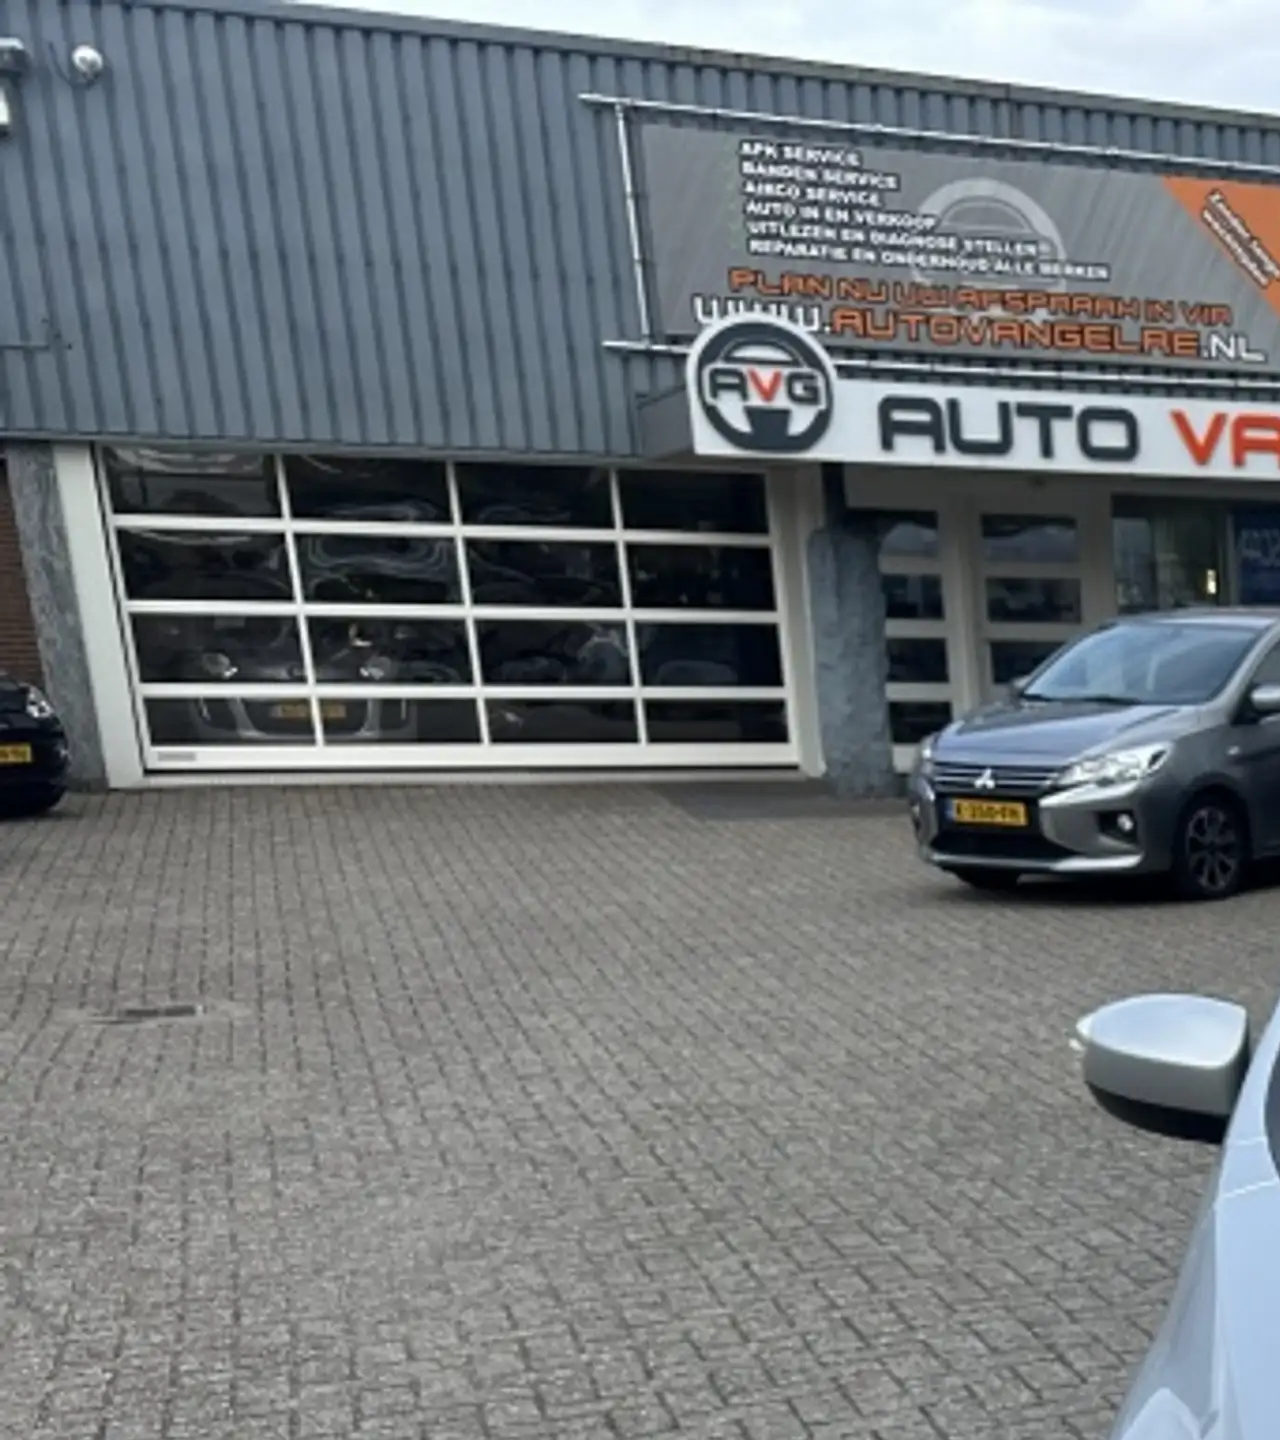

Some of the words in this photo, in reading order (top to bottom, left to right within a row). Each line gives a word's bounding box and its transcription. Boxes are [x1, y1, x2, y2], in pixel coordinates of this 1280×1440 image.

[741, 142, 777, 159] APK
[783, 146, 860, 166] SERVICE
[741, 161, 817, 179] BANDEN
[822, 169, 897, 189] SERVICE
[744, 181, 800, 199] AIRCO
[805, 187, 879, 207] SERVICE
[745, 200, 796, 217] AUTO
[799, 206, 819, 220] IN
[824, 206, 849, 222] EN
[853, 210, 936, 229] VERKOOP
[746, 221, 837, 239] UITLEZEN
[840, 228, 864, 242] EN
[869, 231, 957, 250] DIAGNOSE
[749, 240, 848, 260] REPARATIE
[851, 247, 876, 262] EN
[881, 251, 989, 273] ONDERHOUD
[993, 259, 1034, 275] ALLE
[729, 267, 831, 299] PLAN
[839, 276, 887, 302] NU
[956, 287, 1141, 321] AFSPRAAK
[1144, 297, 1176, 324] IN
[1179, 301, 1233, 328] VIA
[708, 367, 821, 405] AVG
[877, 394, 1140, 462] AUTO
